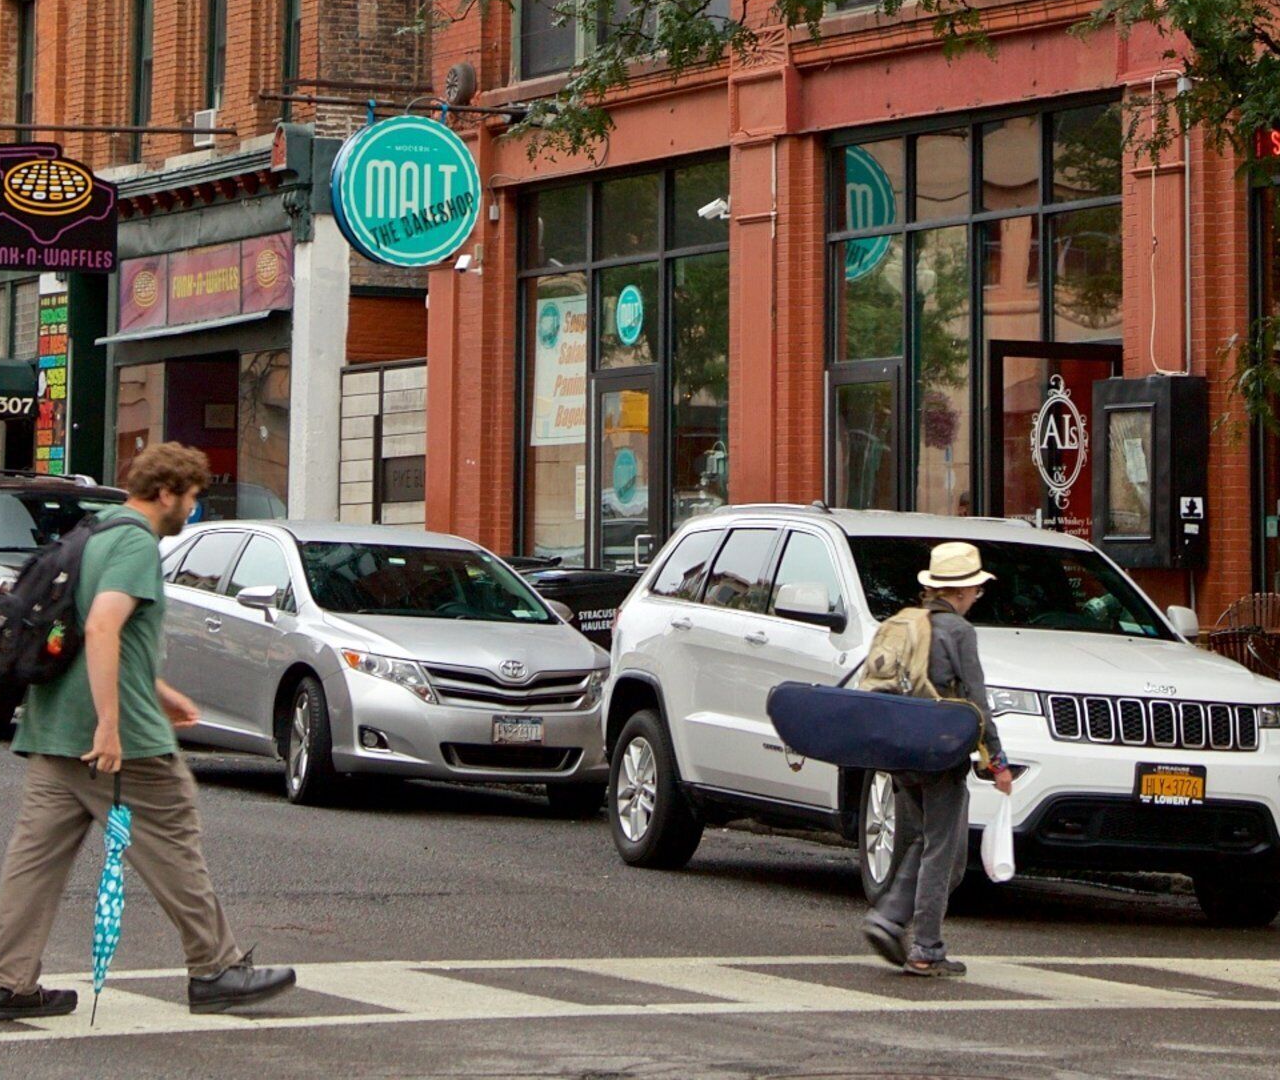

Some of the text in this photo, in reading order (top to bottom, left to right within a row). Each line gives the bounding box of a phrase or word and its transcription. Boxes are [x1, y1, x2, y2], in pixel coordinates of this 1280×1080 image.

[365, 159, 458, 220] MALT
[370, 191, 475, 249] THE BAKESHOP
[1143, 682, 1177, 696] Jeep
